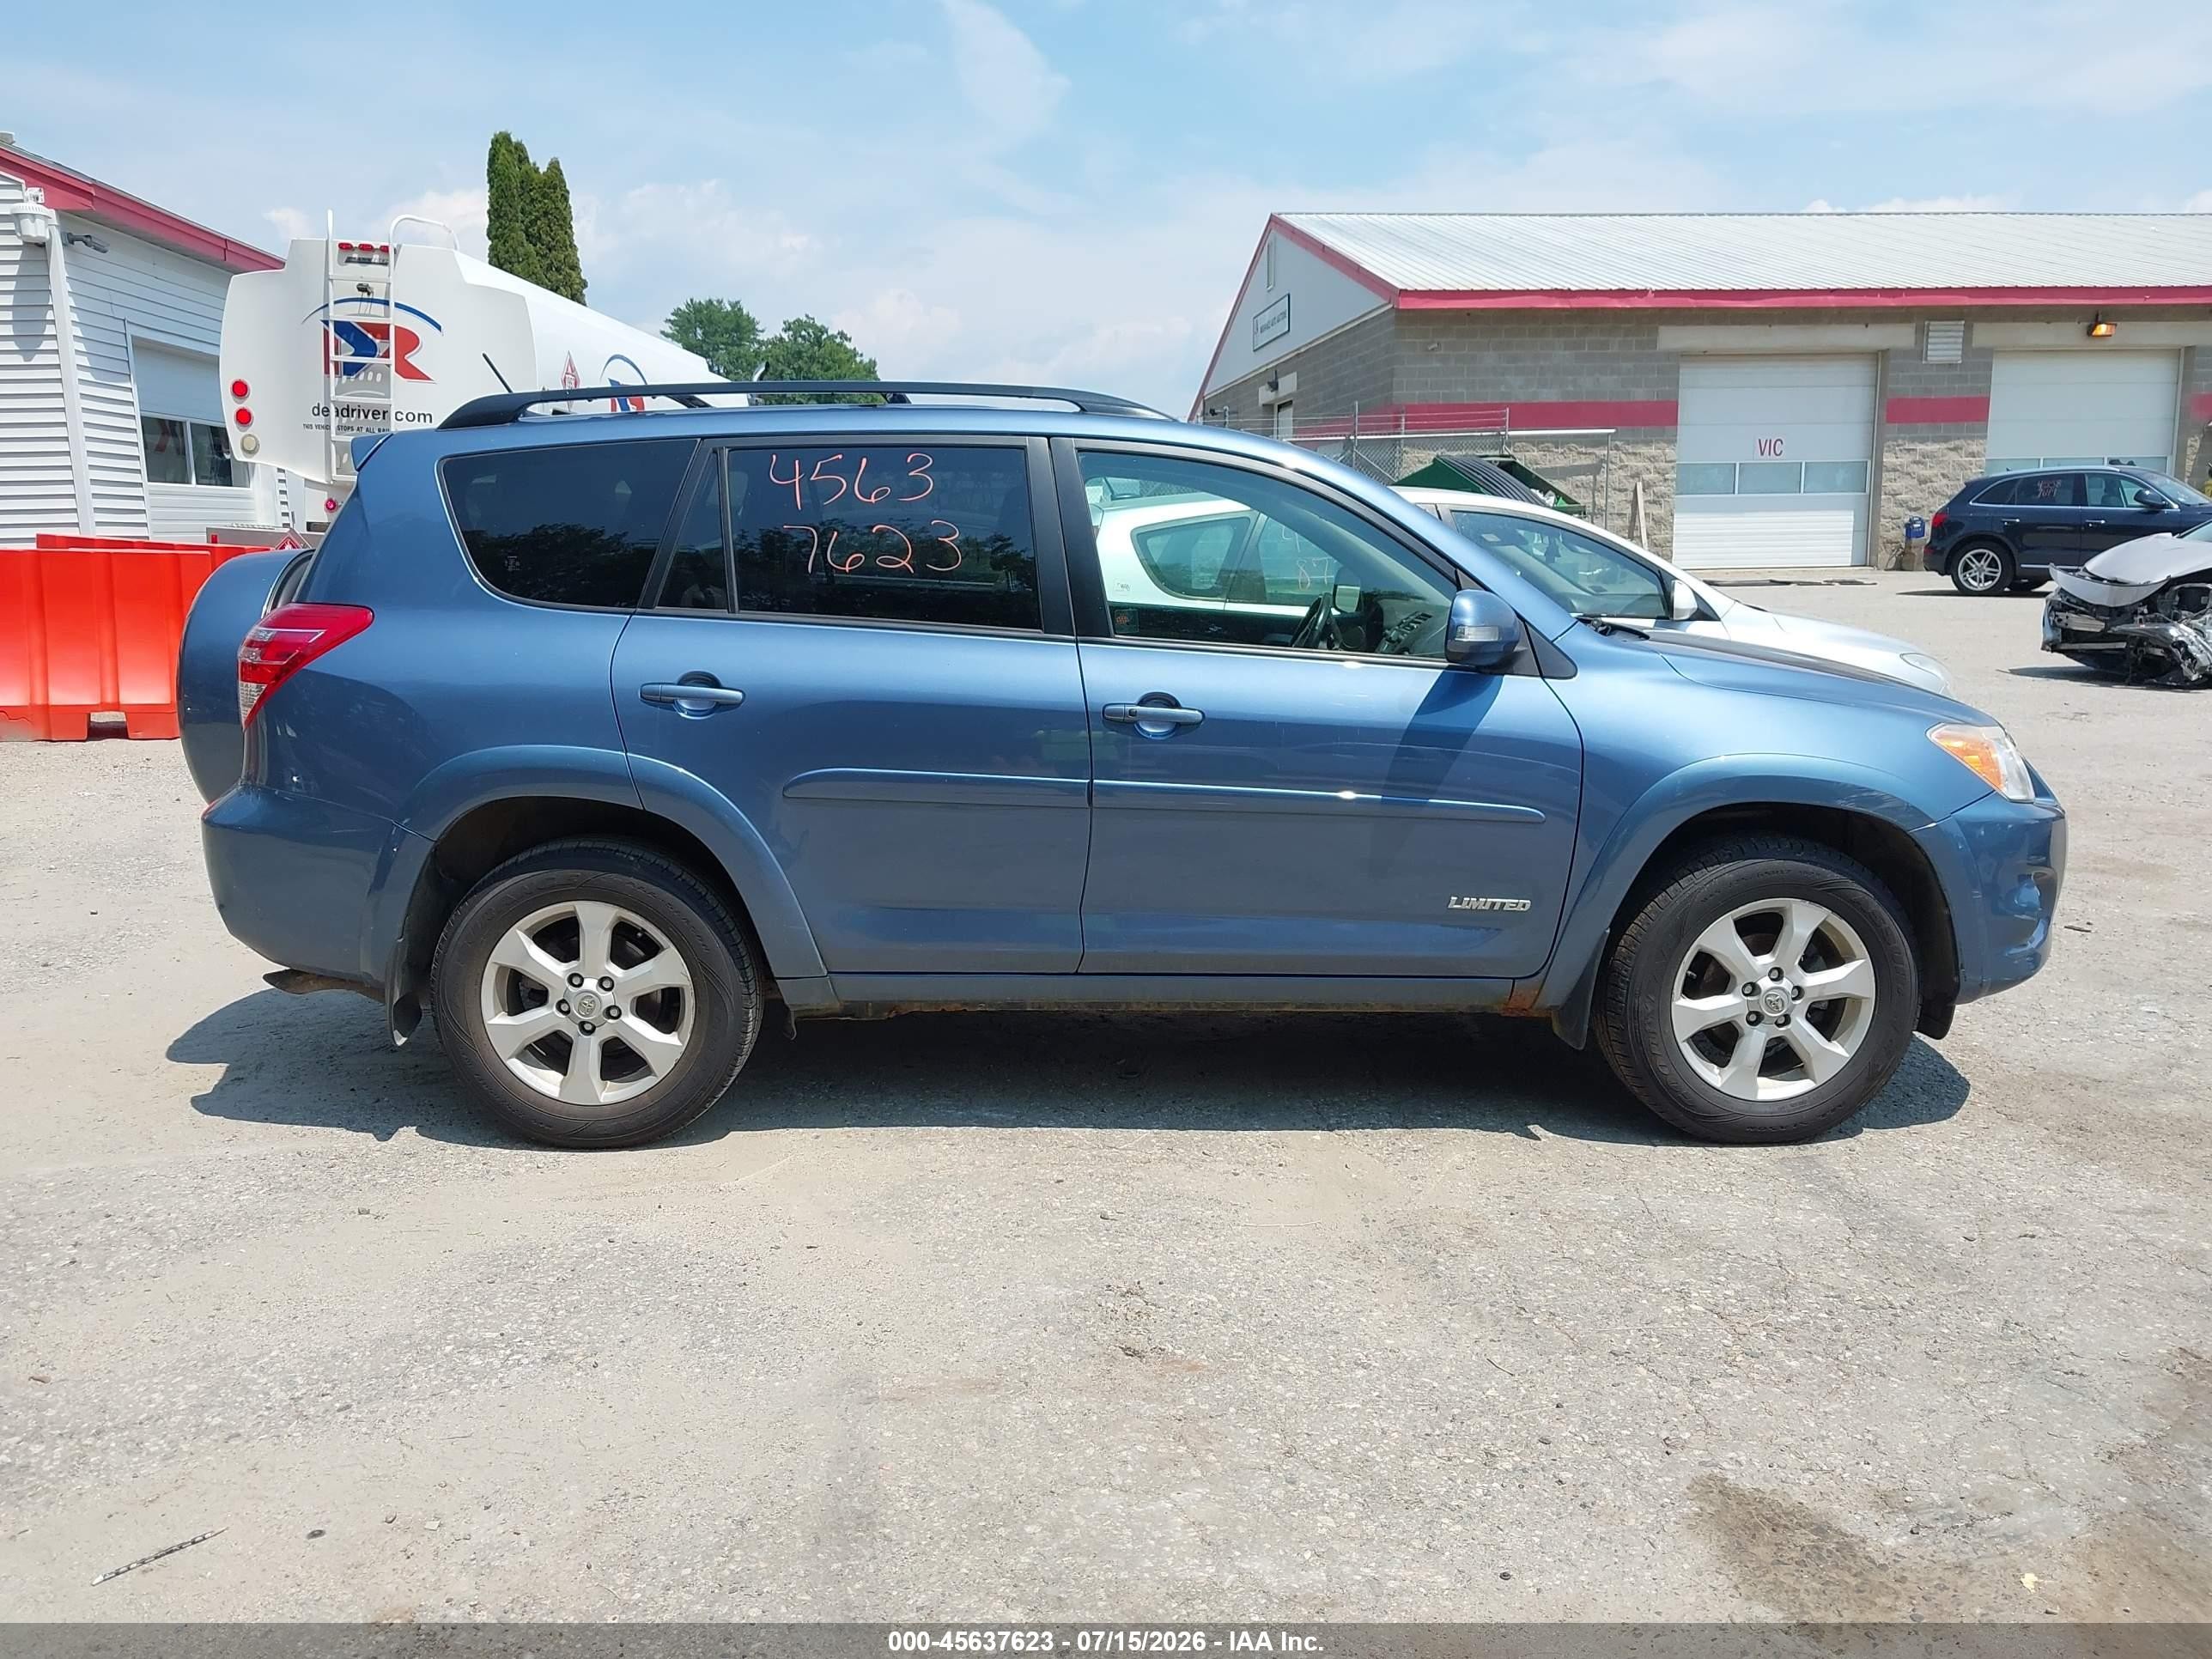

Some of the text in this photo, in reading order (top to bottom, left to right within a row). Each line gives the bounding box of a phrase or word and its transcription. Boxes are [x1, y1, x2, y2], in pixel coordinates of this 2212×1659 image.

[1758, 438, 1784, 456] VIC
[769, 453, 934, 511] 4563
[783, 520, 963, 574] 7623
[1448, 896, 1531, 911] LIMITED
